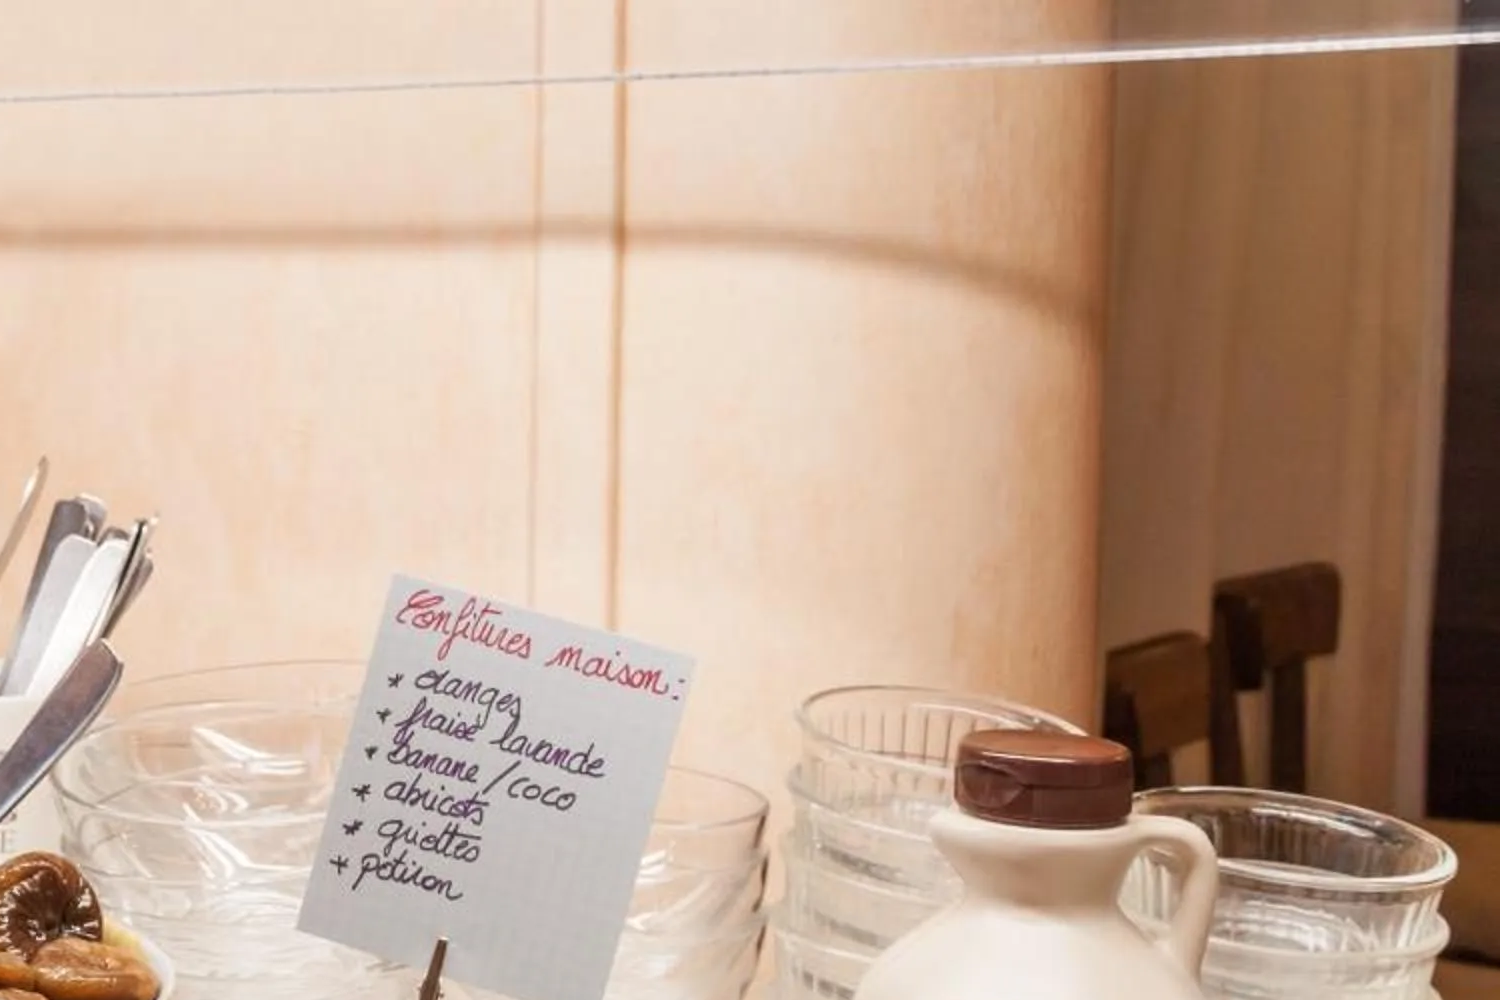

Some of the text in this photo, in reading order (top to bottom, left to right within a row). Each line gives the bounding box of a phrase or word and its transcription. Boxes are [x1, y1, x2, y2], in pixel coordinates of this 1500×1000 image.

[396, 589, 533, 661] Confitures
[392, 696, 606, 780] fraise lavande
[384, 774, 490, 826] abricots
[352, 849, 464, 902] potiron
